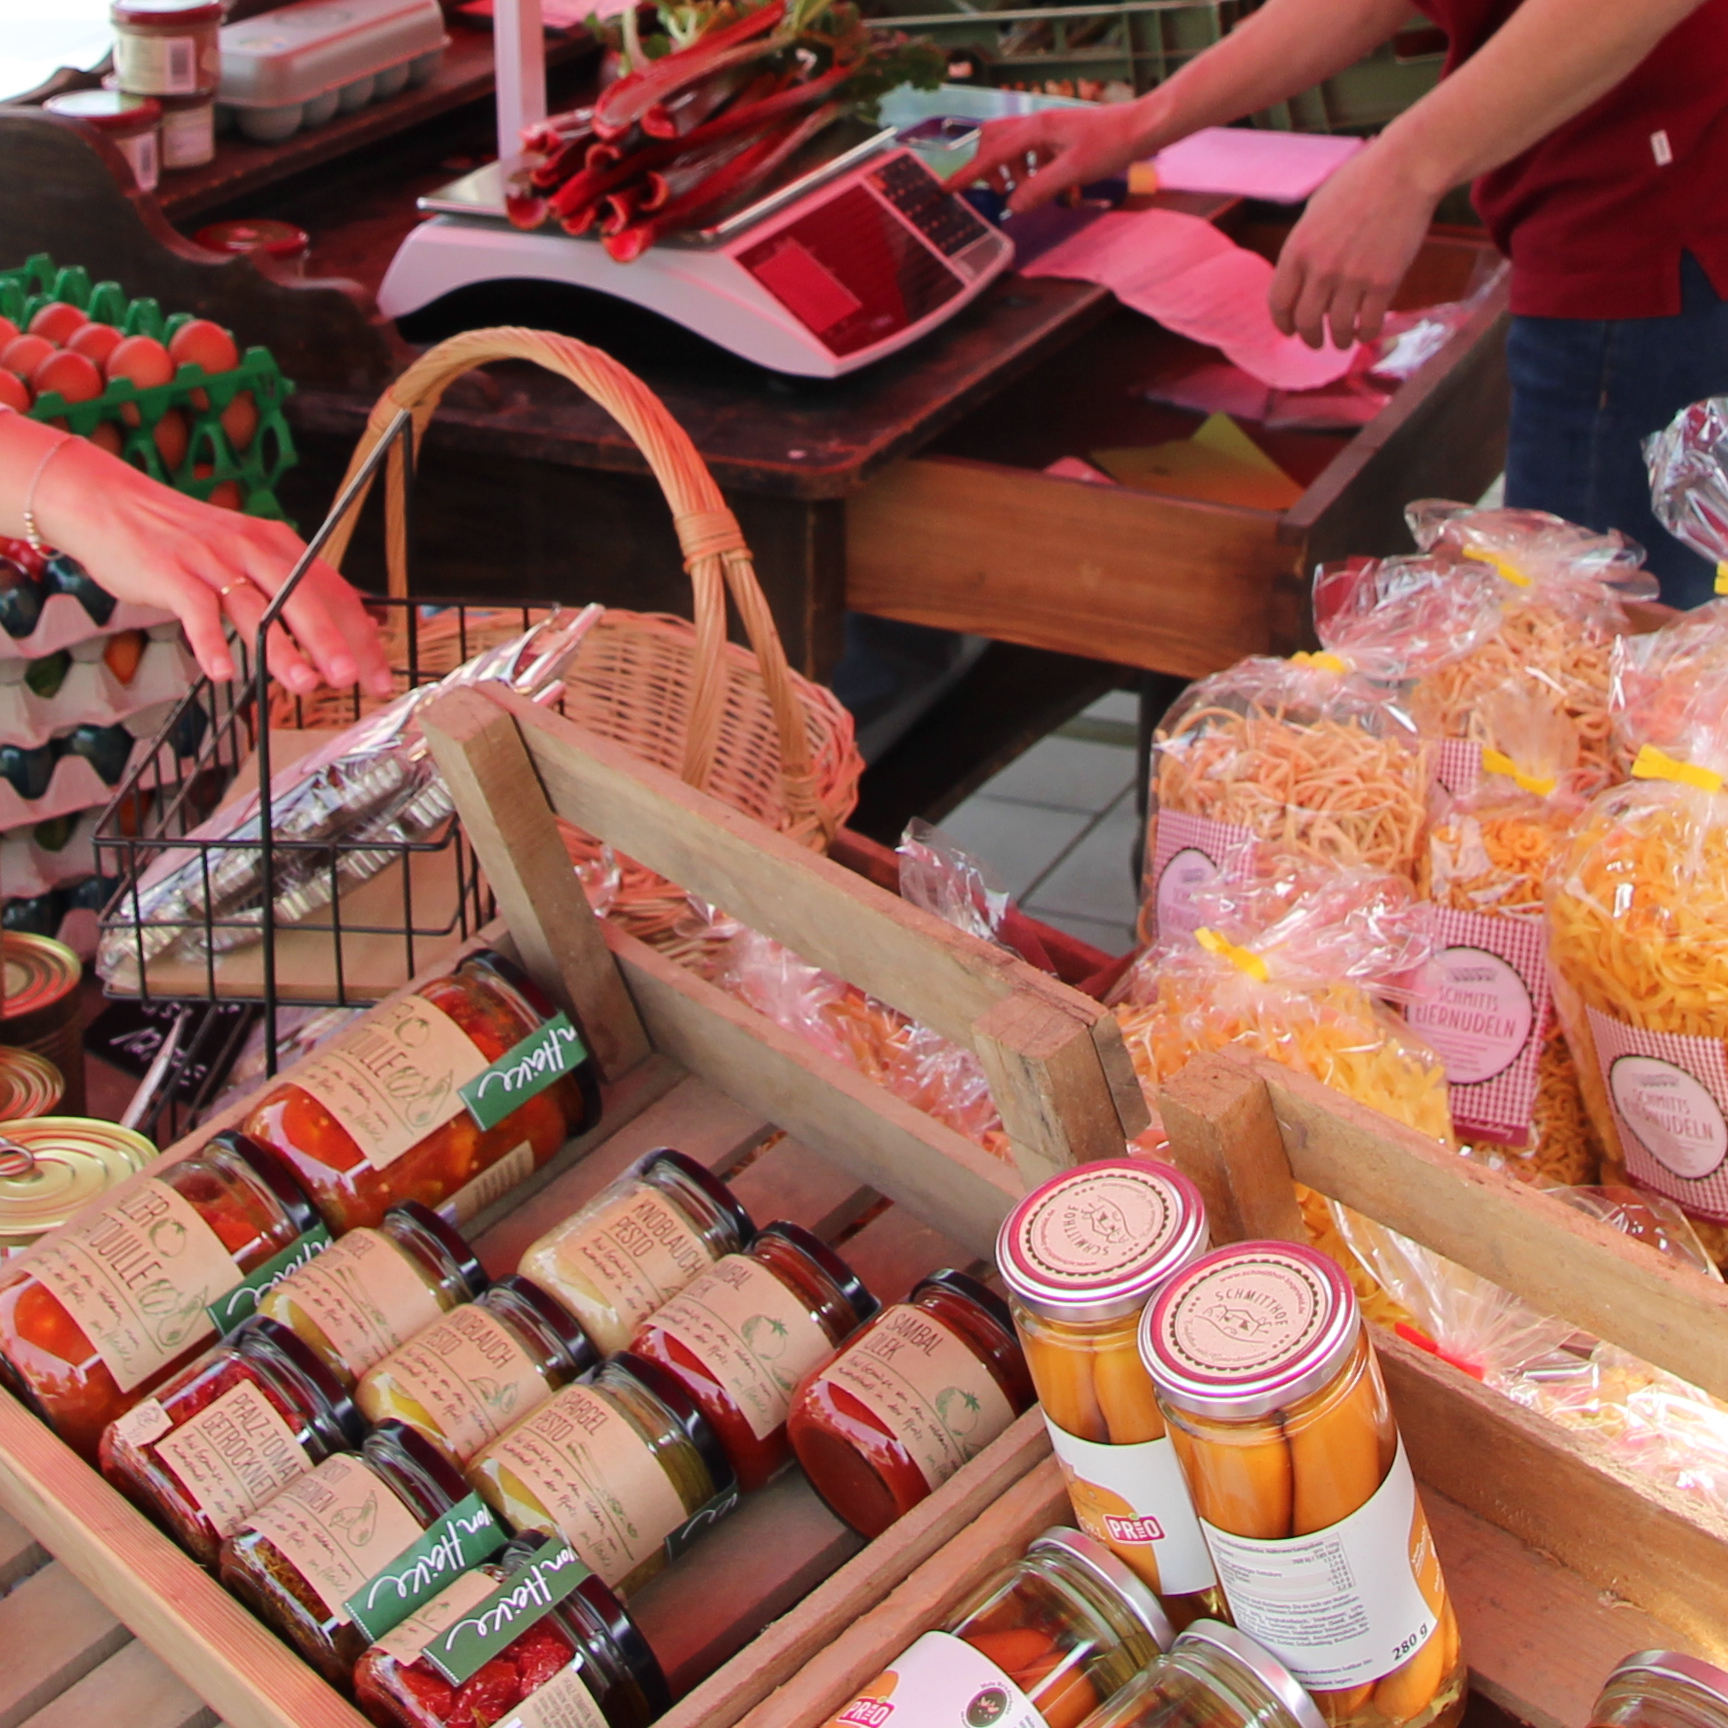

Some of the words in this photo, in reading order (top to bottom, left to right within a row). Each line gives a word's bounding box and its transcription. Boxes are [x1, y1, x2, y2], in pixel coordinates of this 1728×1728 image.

[1416, 1005, 1516, 1038] EIERNUDELN
[1438, 987, 1499, 1012] SCHMITTS
[475, 1028, 566, 1100] Heike
[608, 1214, 655, 1260] PESTO
[630, 1196, 705, 1278] KNOBLAUCH
[1063, 1205, 1110, 1256] SCHMITTHOF
[1215, 1287, 1289, 1327] SCHMITTHOF
[863, 1329, 905, 1361] OLEK
[884, 1308, 943, 1357] SAMBAL
[530, 1407, 574, 1443] PESTO
[553, 1387, 609, 1437] SPARGEL
[200, 1408, 278, 1500] GETROCKNET
[225, 1390, 306, 1486] PFALZ-TOMAT
[368, 1520, 465, 1611] Heike
[445, 1565, 552, 1651] Heike
[1392, 1636, 1418, 1661] 280
[1419, 1624, 1430, 1640] g
